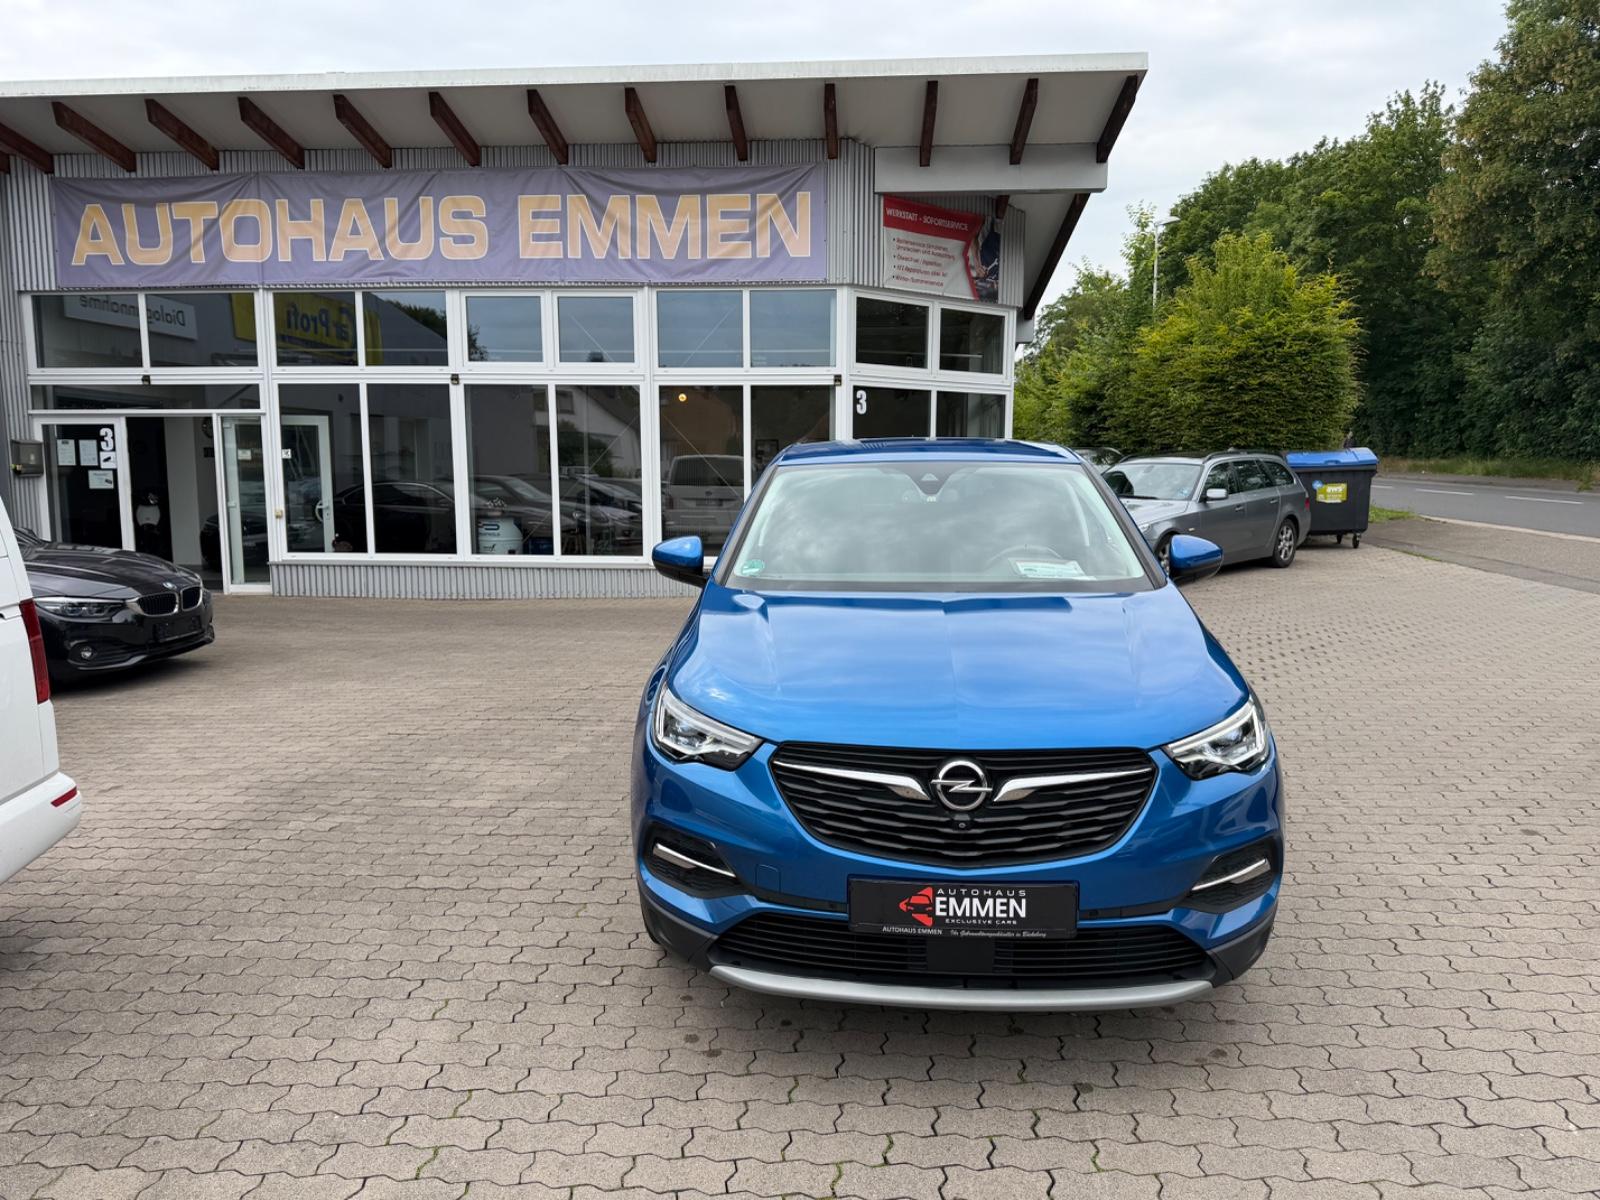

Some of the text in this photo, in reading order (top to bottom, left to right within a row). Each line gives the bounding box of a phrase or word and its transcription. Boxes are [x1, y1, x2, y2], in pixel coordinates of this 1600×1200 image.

[70, 190, 812, 268] AUTOHAUS EMMEN
[856, 389, 867, 415] 3
[99, 427, 114, 452] 3
[937, 888, 1026, 897] AUTOHAUS
[935, 897, 1026, 918] EMMEN
[882, 926, 916, 934] AUTOHAUS
